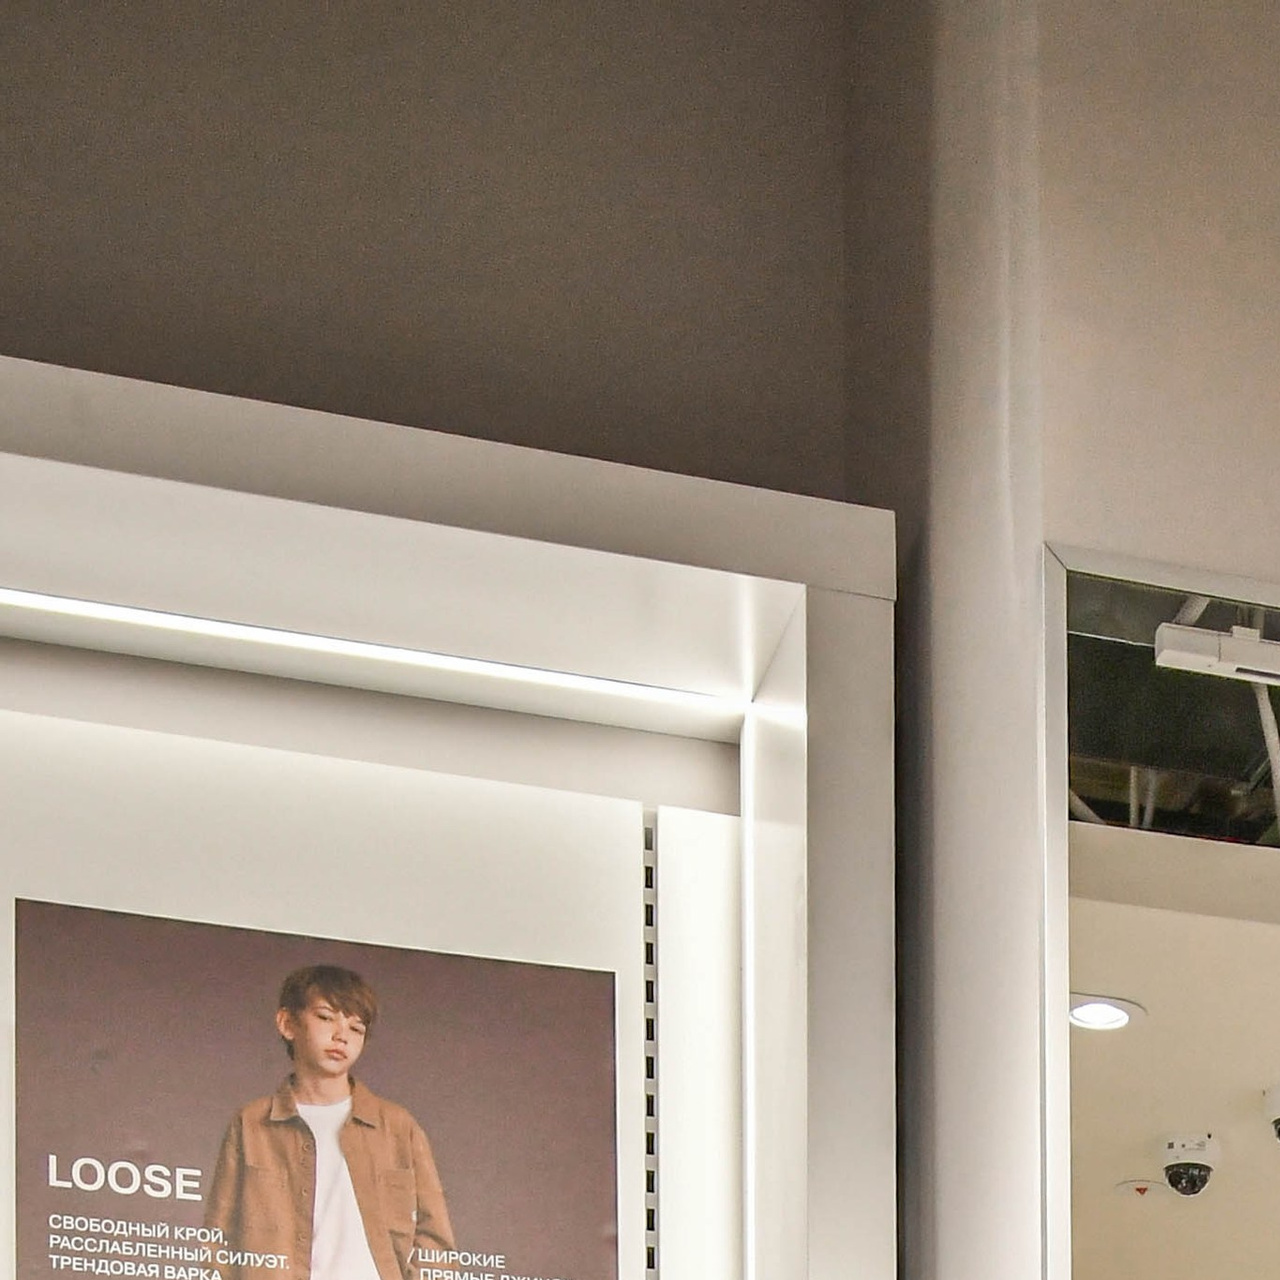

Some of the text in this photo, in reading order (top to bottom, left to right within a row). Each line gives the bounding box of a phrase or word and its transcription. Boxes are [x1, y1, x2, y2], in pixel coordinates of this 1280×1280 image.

[48, 1153, 204, 1201] LOOSE
[48, 1214, 229, 1246] СВОБОДНЫЙ КРОЙ,
[48, 1234, 290, 1270] РАССЛАБЛЕННЫЙ СИЛУЭТ.
[48, 1254, 161, 1278] ТРЕНДОВАЯ
[417, 1248, 506, 1269] ШИРОКИЕ
